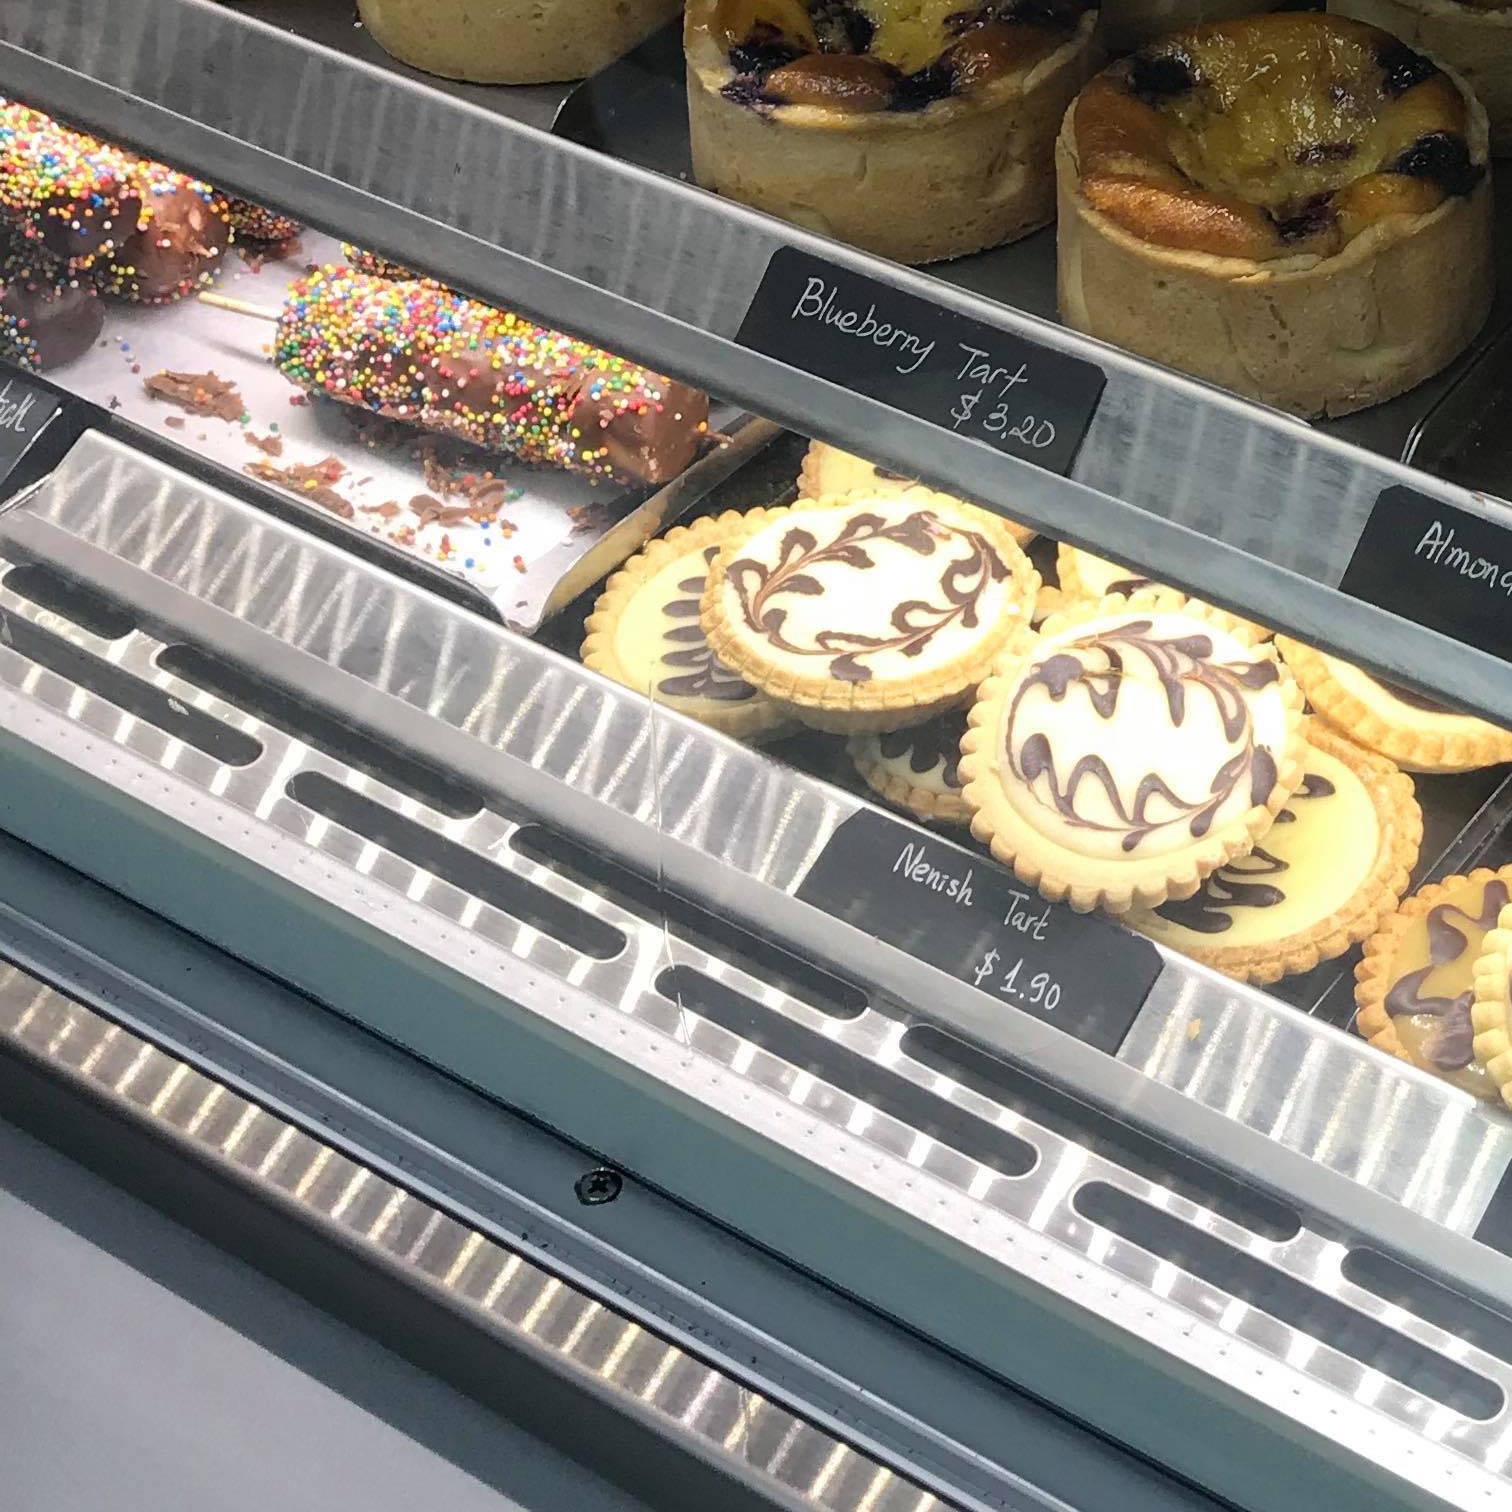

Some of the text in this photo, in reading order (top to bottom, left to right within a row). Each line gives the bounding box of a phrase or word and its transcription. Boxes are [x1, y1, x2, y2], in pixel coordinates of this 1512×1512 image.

[791, 276, 1028, 399] Blueberry Tart
[892, 842, 1052, 941] Nenish Tart
